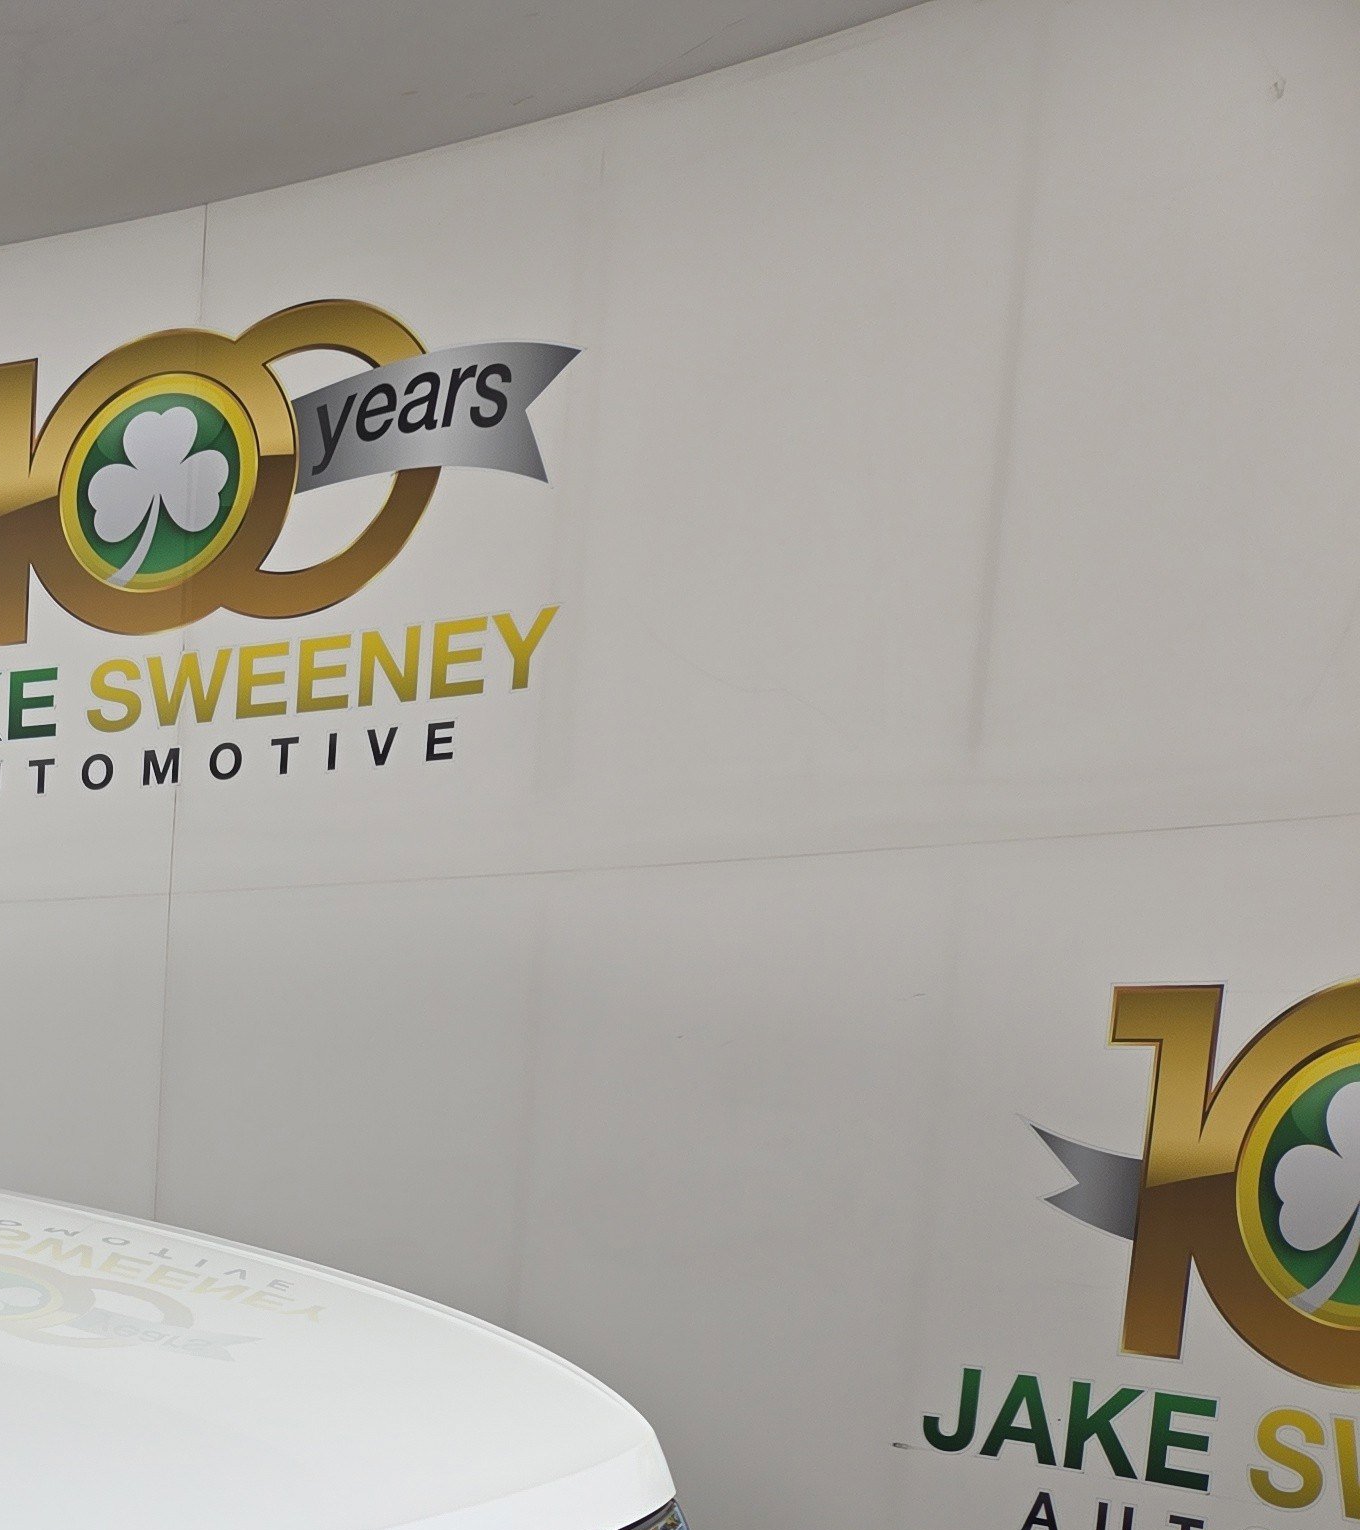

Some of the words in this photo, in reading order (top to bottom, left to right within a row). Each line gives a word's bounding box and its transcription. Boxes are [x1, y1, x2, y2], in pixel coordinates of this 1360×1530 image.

[311, 361, 512, 476] years
[86, 605, 560, 734] SWEENEY
[921, 1367, 1218, 1492] JAKE
